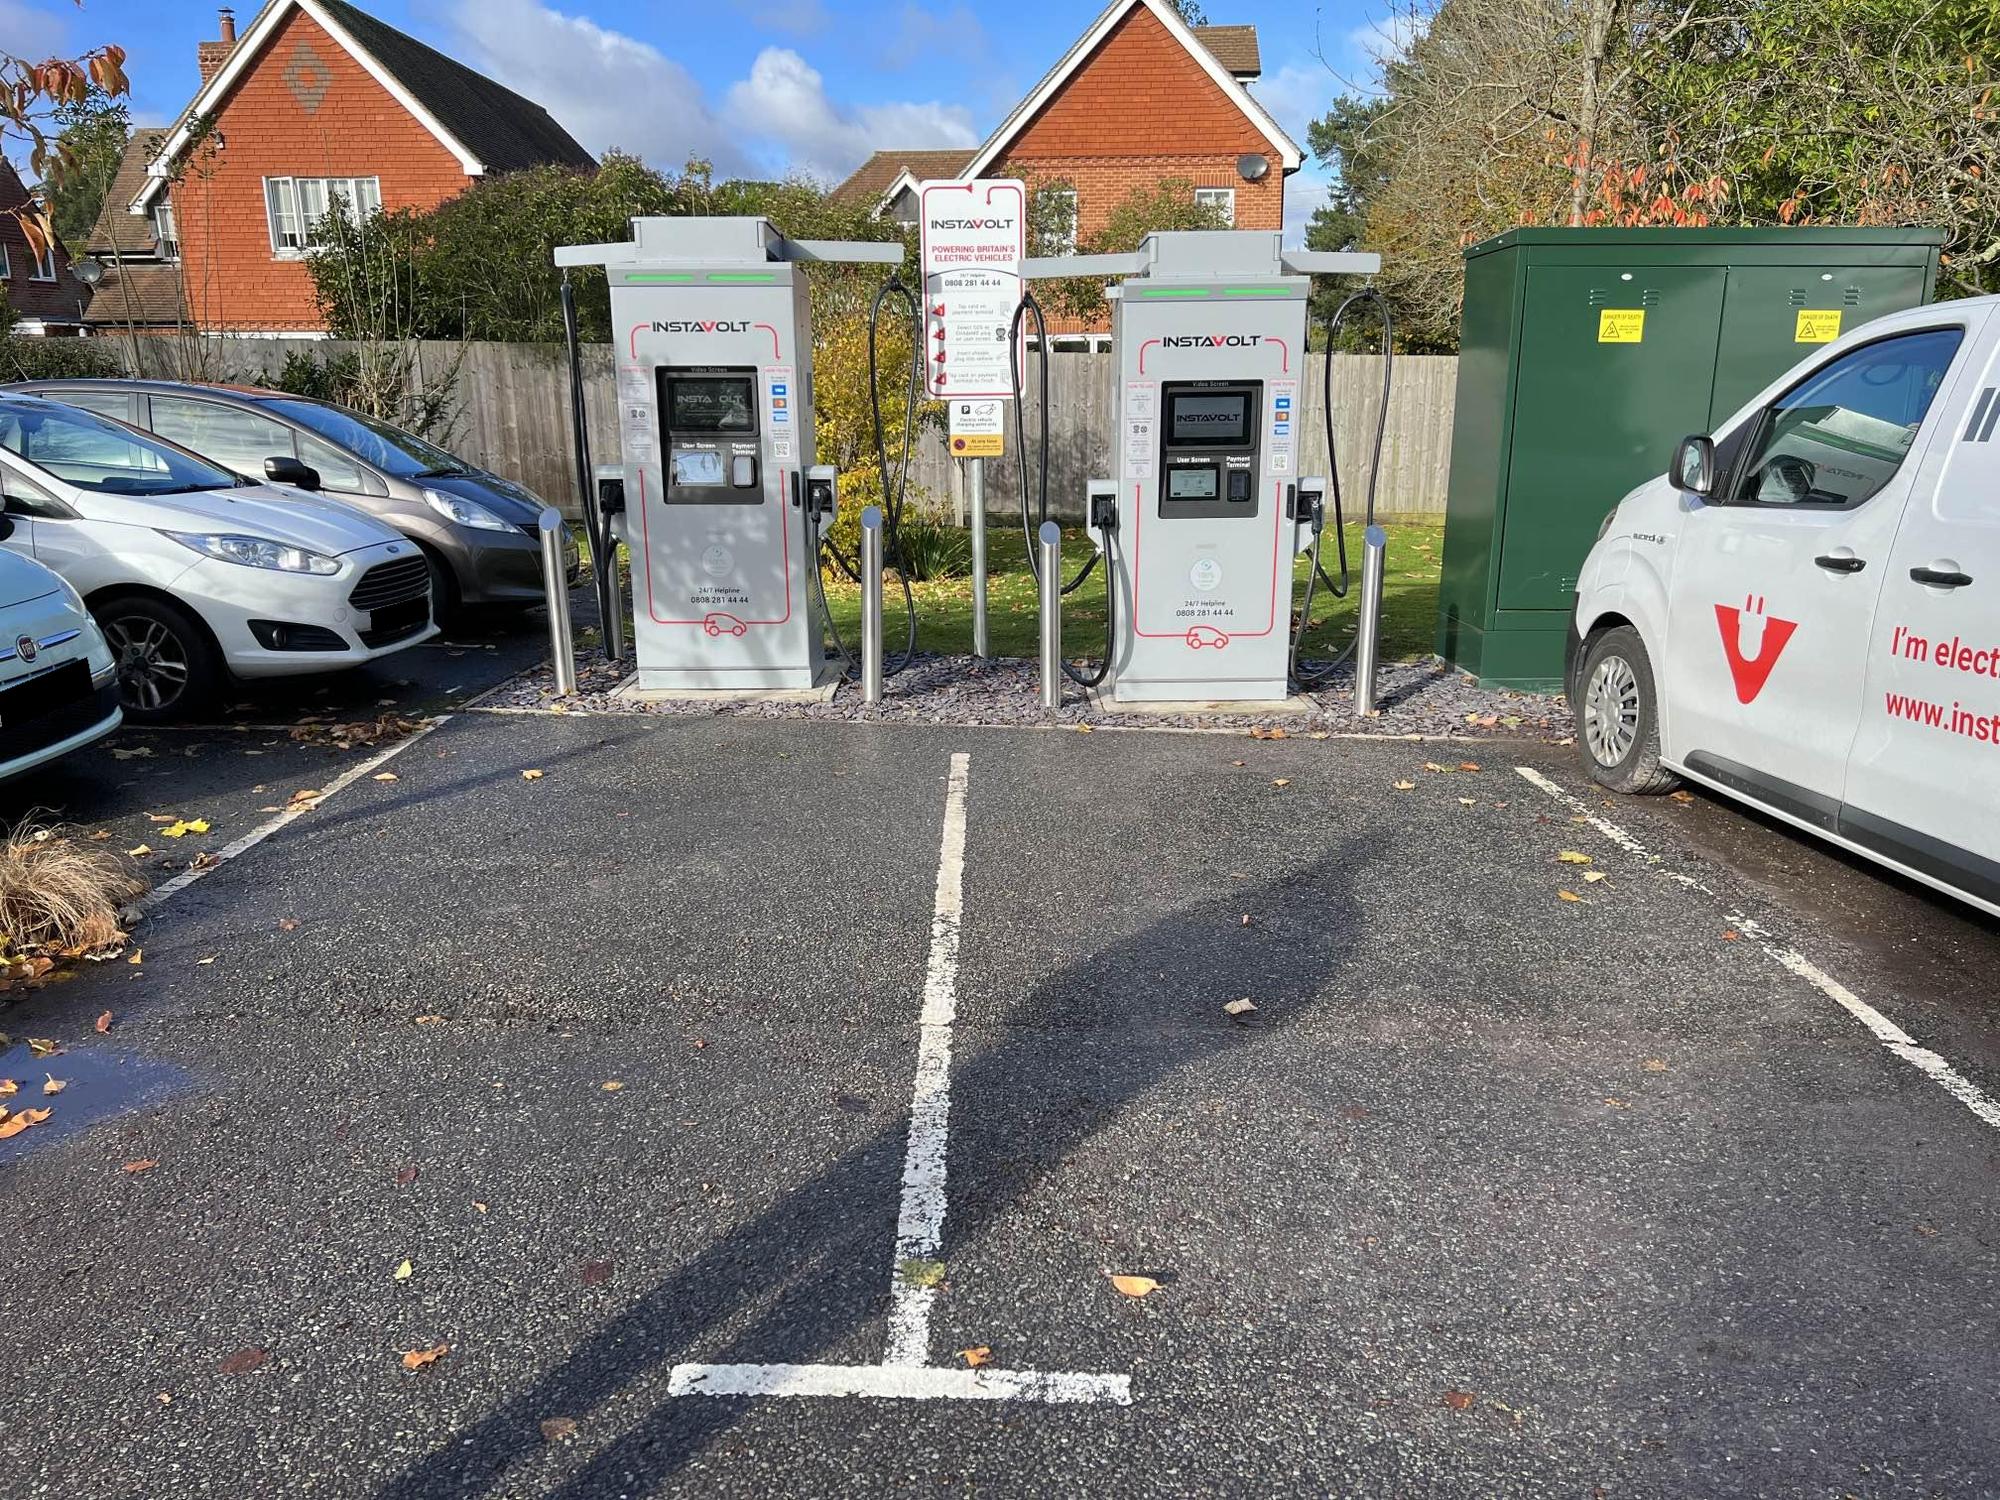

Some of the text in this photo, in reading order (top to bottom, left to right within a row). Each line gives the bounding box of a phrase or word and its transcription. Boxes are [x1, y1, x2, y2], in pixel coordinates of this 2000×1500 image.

[931, 219, 1014, 229] INSTAVOLT
[977, 245, 1015, 253] BRITAIN'S
[935, 253, 1013, 262] ELECTRIC VEHICLES
[652, 321, 752, 333] INSTAVOLT
[1163, 335, 1263, 348] INSTAVOLT
[677, 395, 743, 404] INSTAOLT
[1176, 413, 1240, 422] INSTAVOLT
[714, 587, 740, 595] Helpline
[1891, 626, 2000, 678] I'm elect
[1886, 692, 2000, 745] www.inst
